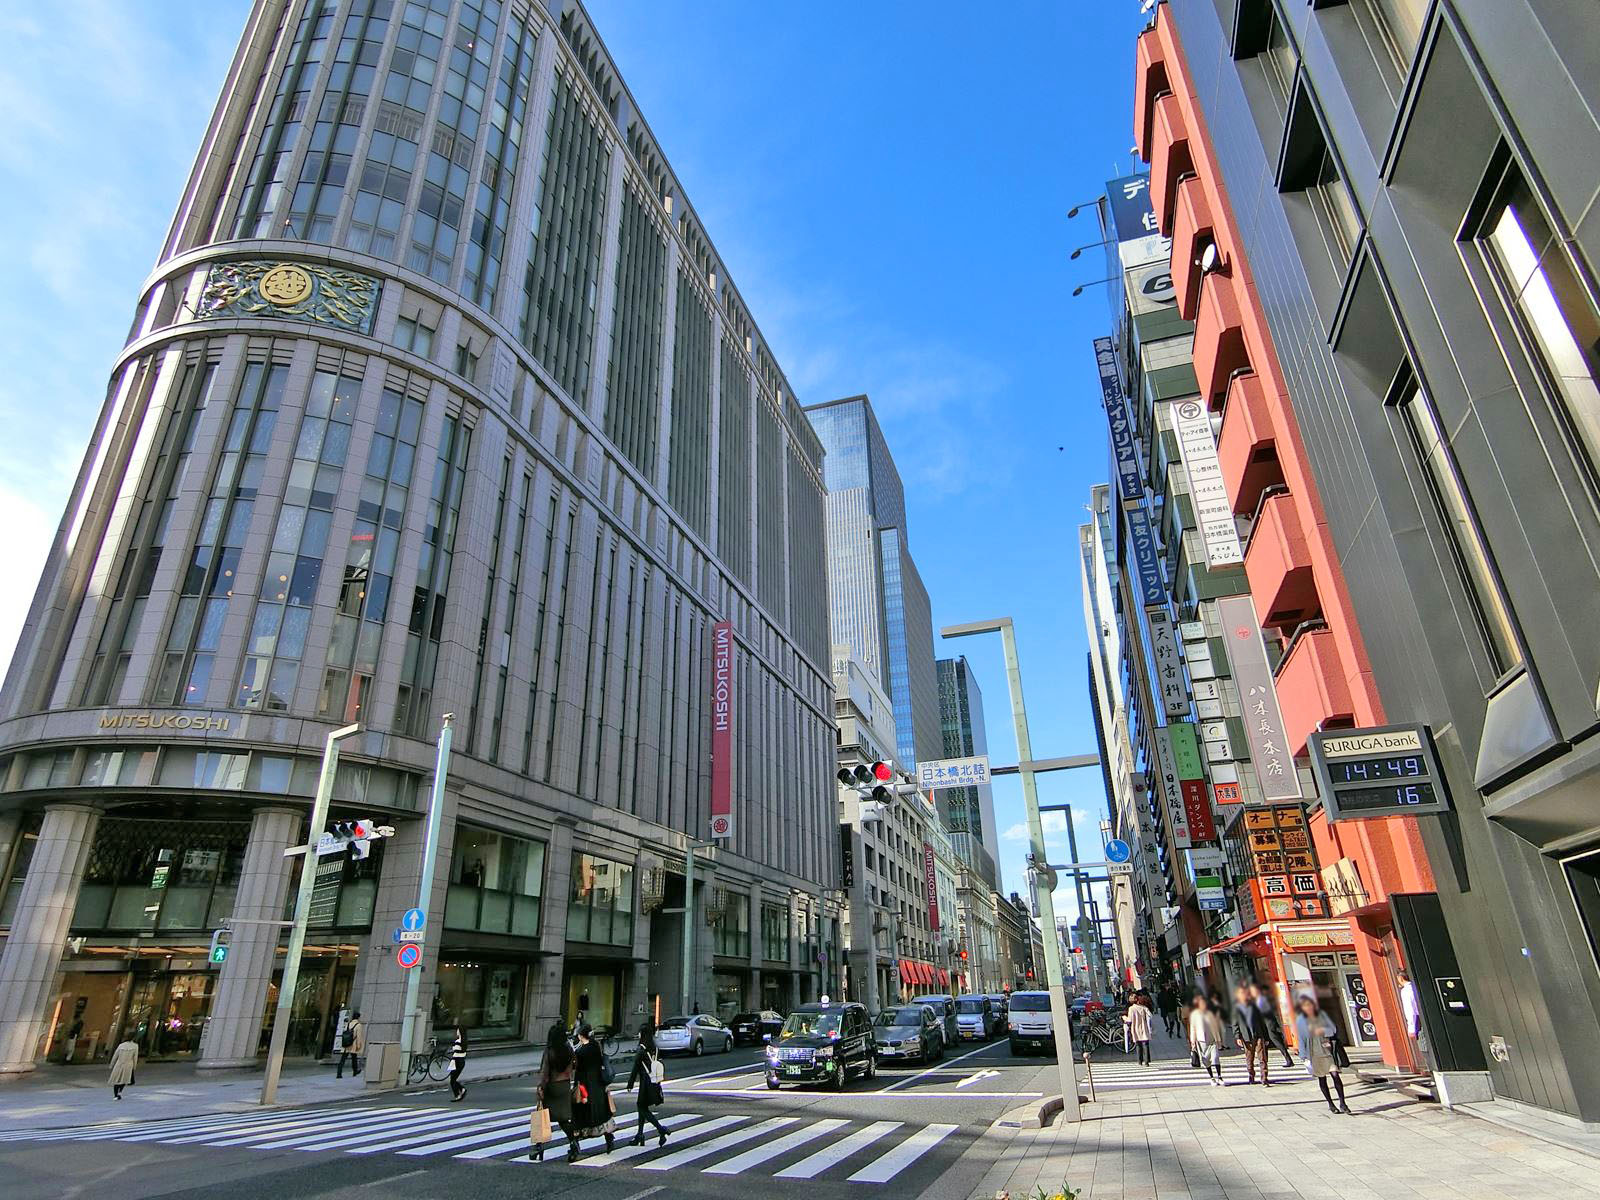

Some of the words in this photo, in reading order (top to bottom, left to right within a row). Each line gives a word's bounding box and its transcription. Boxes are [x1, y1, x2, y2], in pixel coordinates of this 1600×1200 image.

[717, 628, 728, 731] MITSUKOSHI
[1170, 703, 1183, 711] 3F
[100, 714, 230, 731] MITSUKOSHI
[1323, 737, 1382, 754] SURUGA
[1385, 735, 1417, 747] bank
[923, 763, 985, 780] 日本橋北詰
[1346, 758, 1419, 781] 14:49
[922, 778, 957, 788] Nihonbashi
[1397, 786, 1420, 804] 16
[926, 850, 936, 906] MITSUKOSHI
